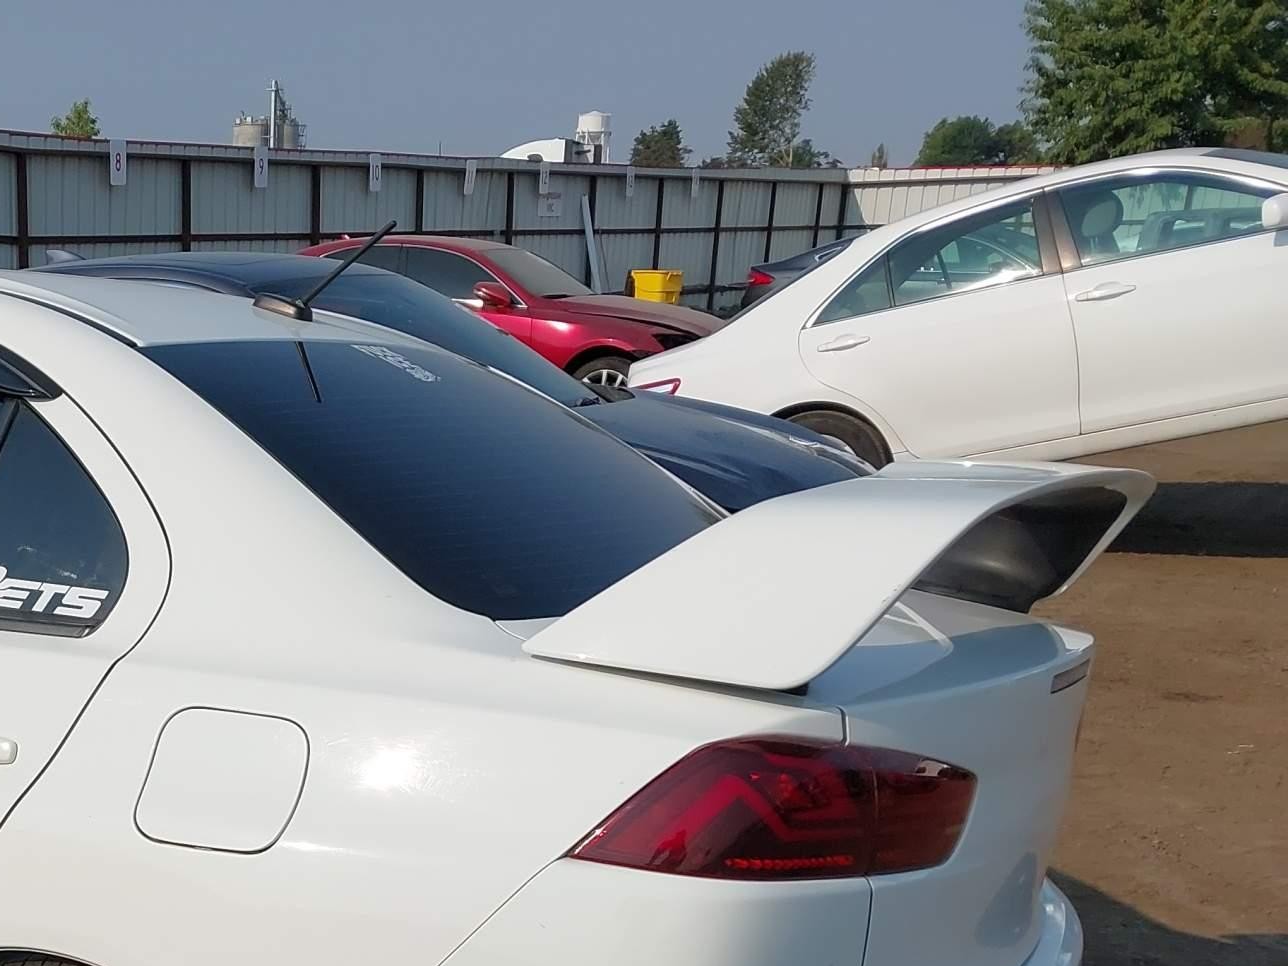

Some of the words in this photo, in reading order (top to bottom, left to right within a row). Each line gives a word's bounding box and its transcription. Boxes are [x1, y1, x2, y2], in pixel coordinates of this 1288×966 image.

[115, 152, 122, 172] 8
[258, 158, 264, 175] 9
[371, 164, 380, 181] 10
[541, 170, 548, 185] 12
